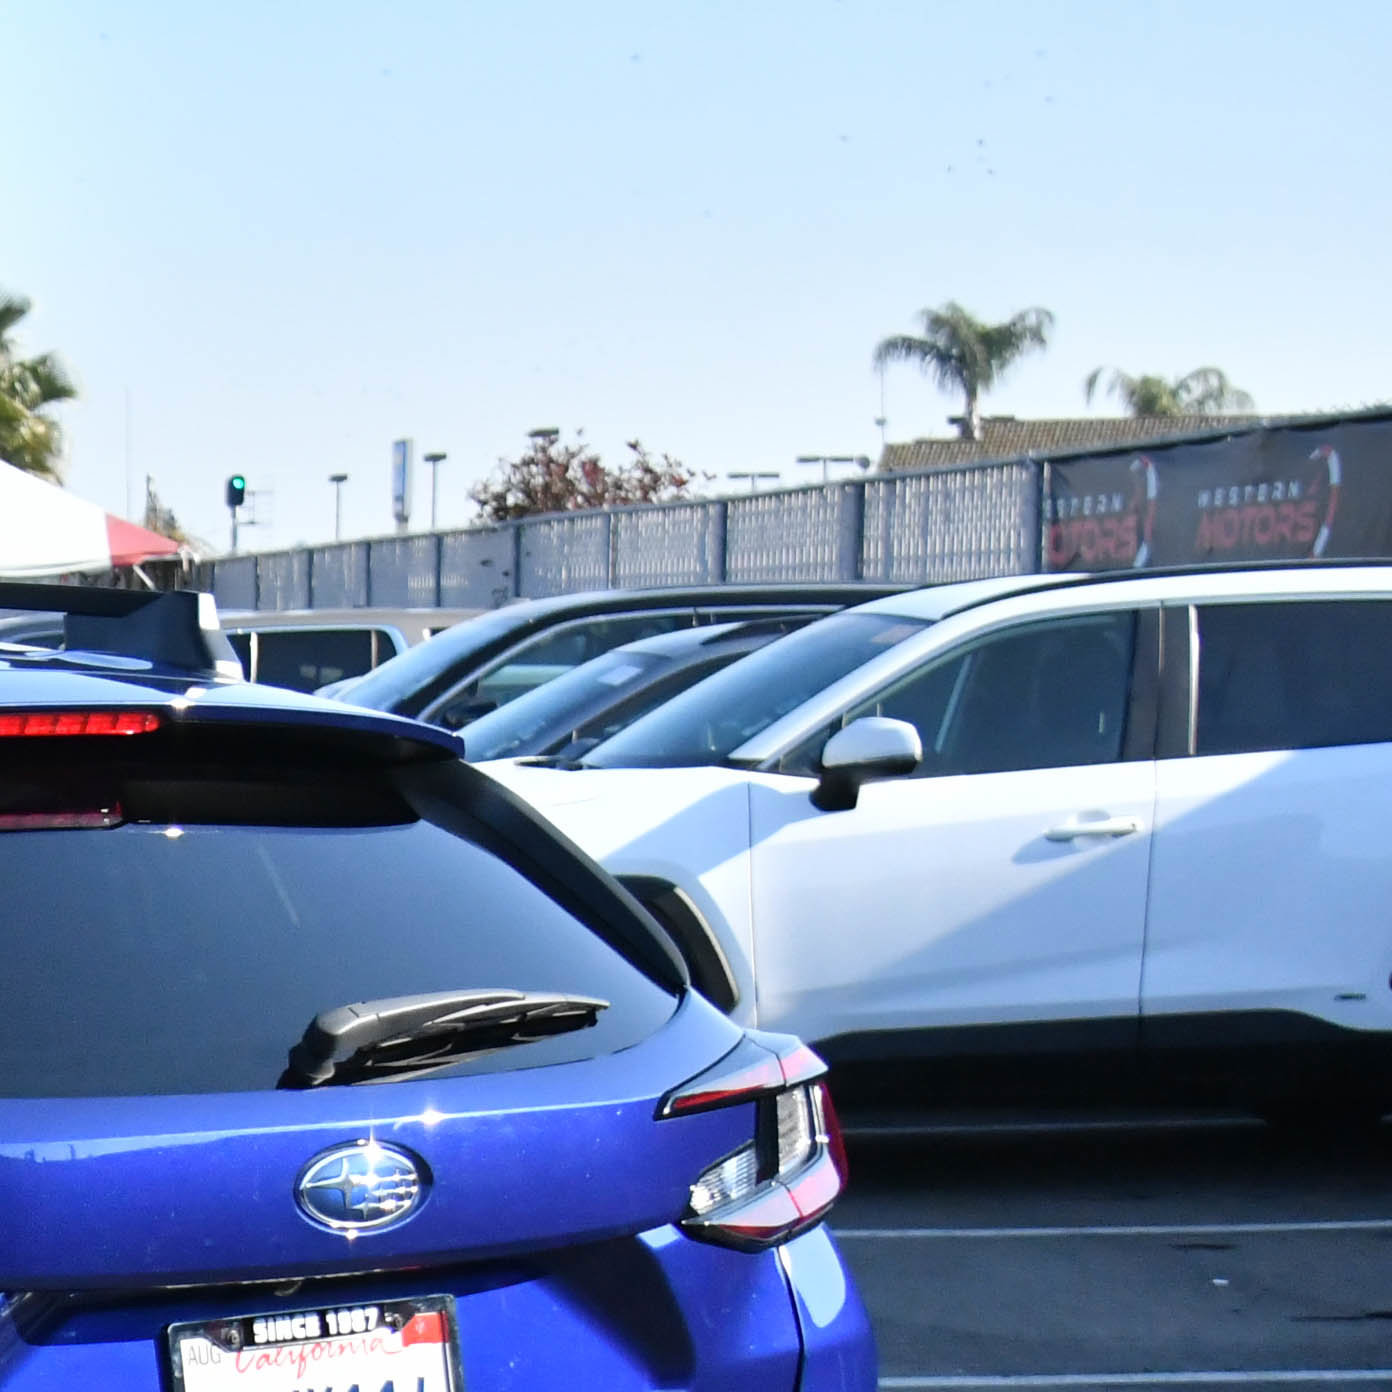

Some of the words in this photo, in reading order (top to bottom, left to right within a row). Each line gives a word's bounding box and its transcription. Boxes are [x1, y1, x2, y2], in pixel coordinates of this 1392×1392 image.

[1198, 480, 1301, 509] WESTERN
[1048, 514, 1138, 567] OTORS
[1195, 501, 1316, 550] MOTORS
[253, 1317, 320, 1344] SINCE
[324, 1307, 380, 1335] 1987
